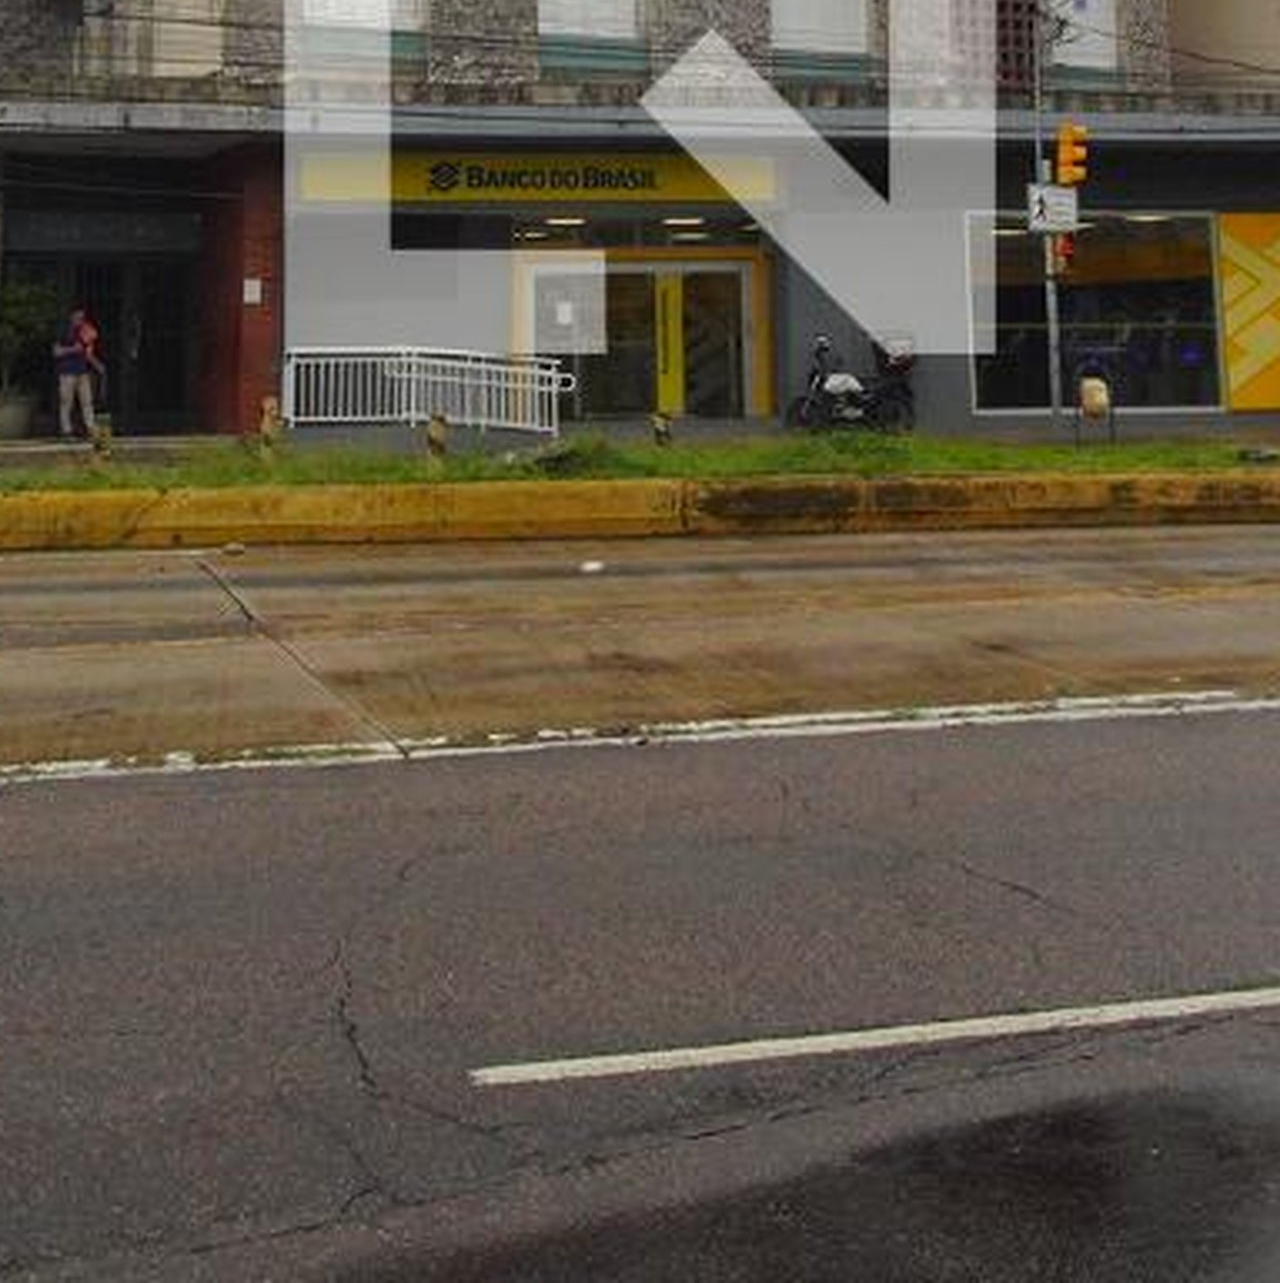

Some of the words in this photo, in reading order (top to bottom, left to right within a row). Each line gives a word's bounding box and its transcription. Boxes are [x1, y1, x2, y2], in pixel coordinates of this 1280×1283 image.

[466, 165, 545, 189] BANCO
[549, 168, 579, 189] DO
[582, 165, 658, 190] BRASIL
